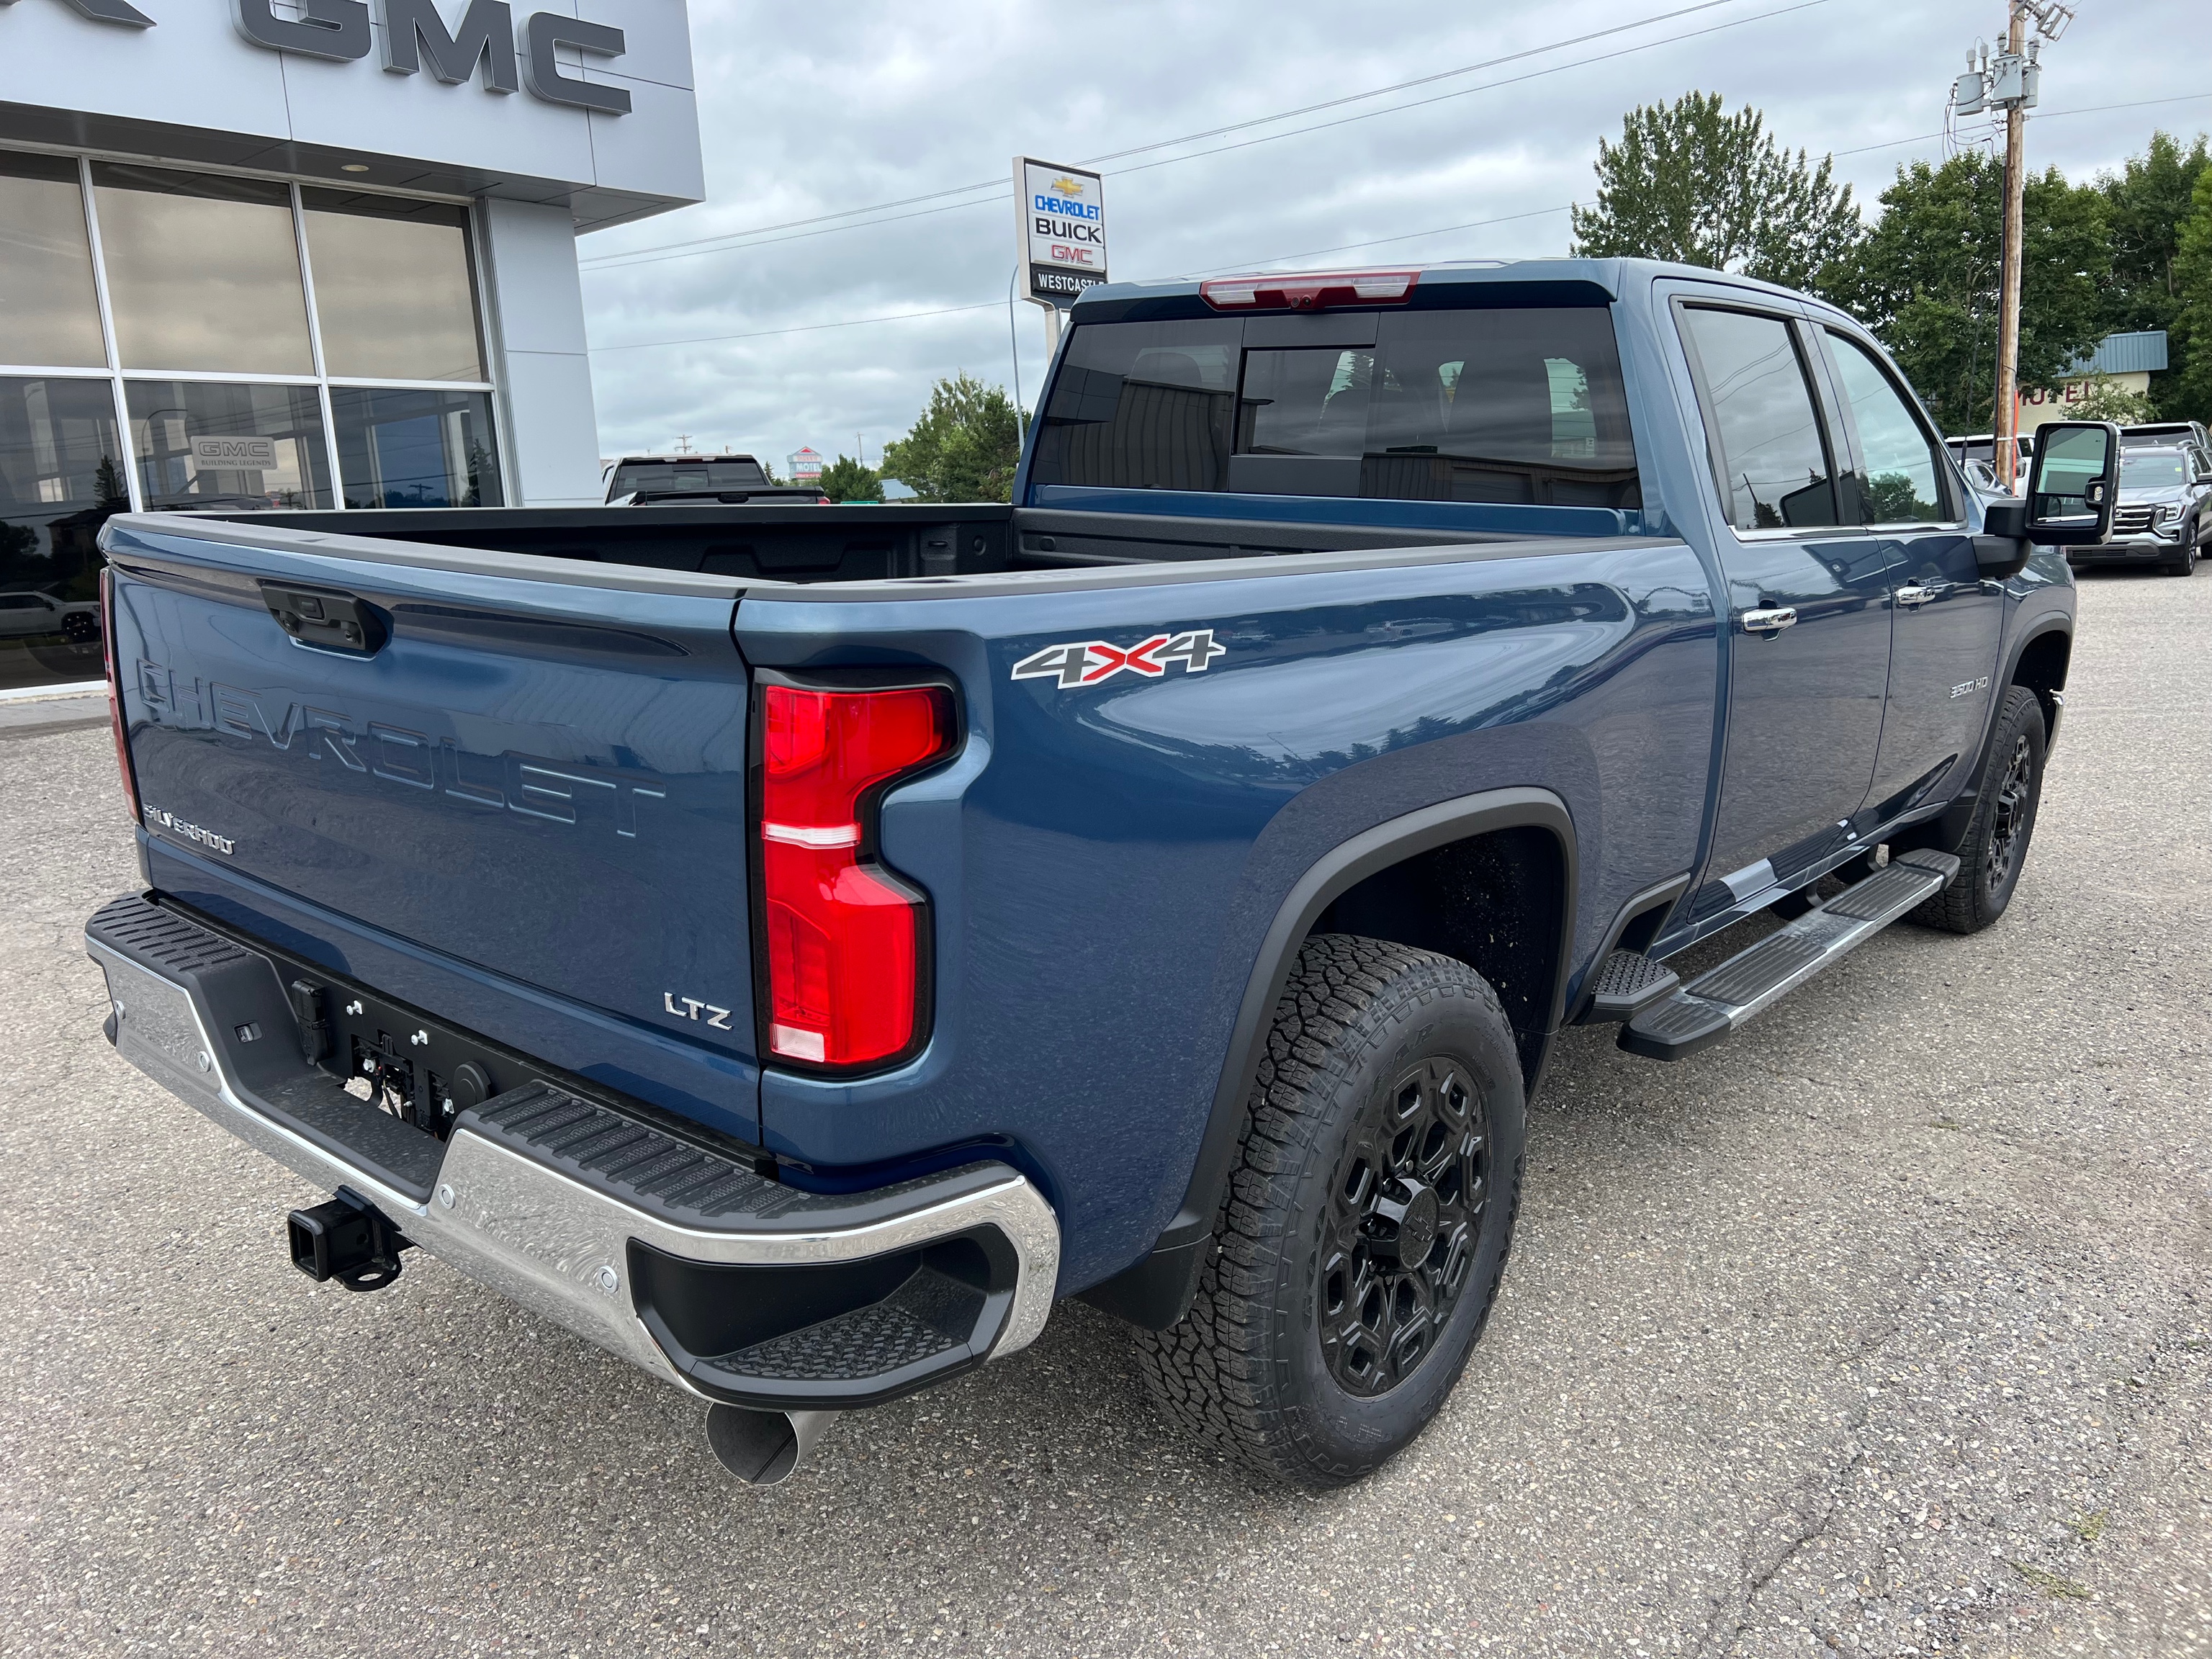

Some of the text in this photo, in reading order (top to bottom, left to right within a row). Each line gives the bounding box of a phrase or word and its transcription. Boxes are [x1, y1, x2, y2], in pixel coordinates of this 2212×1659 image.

[232, 0, 632, 116] GMC
[1035, 194, 1100, 220] CHEVROLET
[1035, 217, 1102, 243] BUICK
[1051, 244, 1093, 265] GMC
[199, 441, 269, 457] GMC
[796, 462, 821, 472] MOTEL
[1974, 676, 1988, 691] HD
[137, 657, 666, 837] CHEVROLET
[143, 802, 235, 855] SILVERADO
[664, 992, 733, 1030] LTZ
